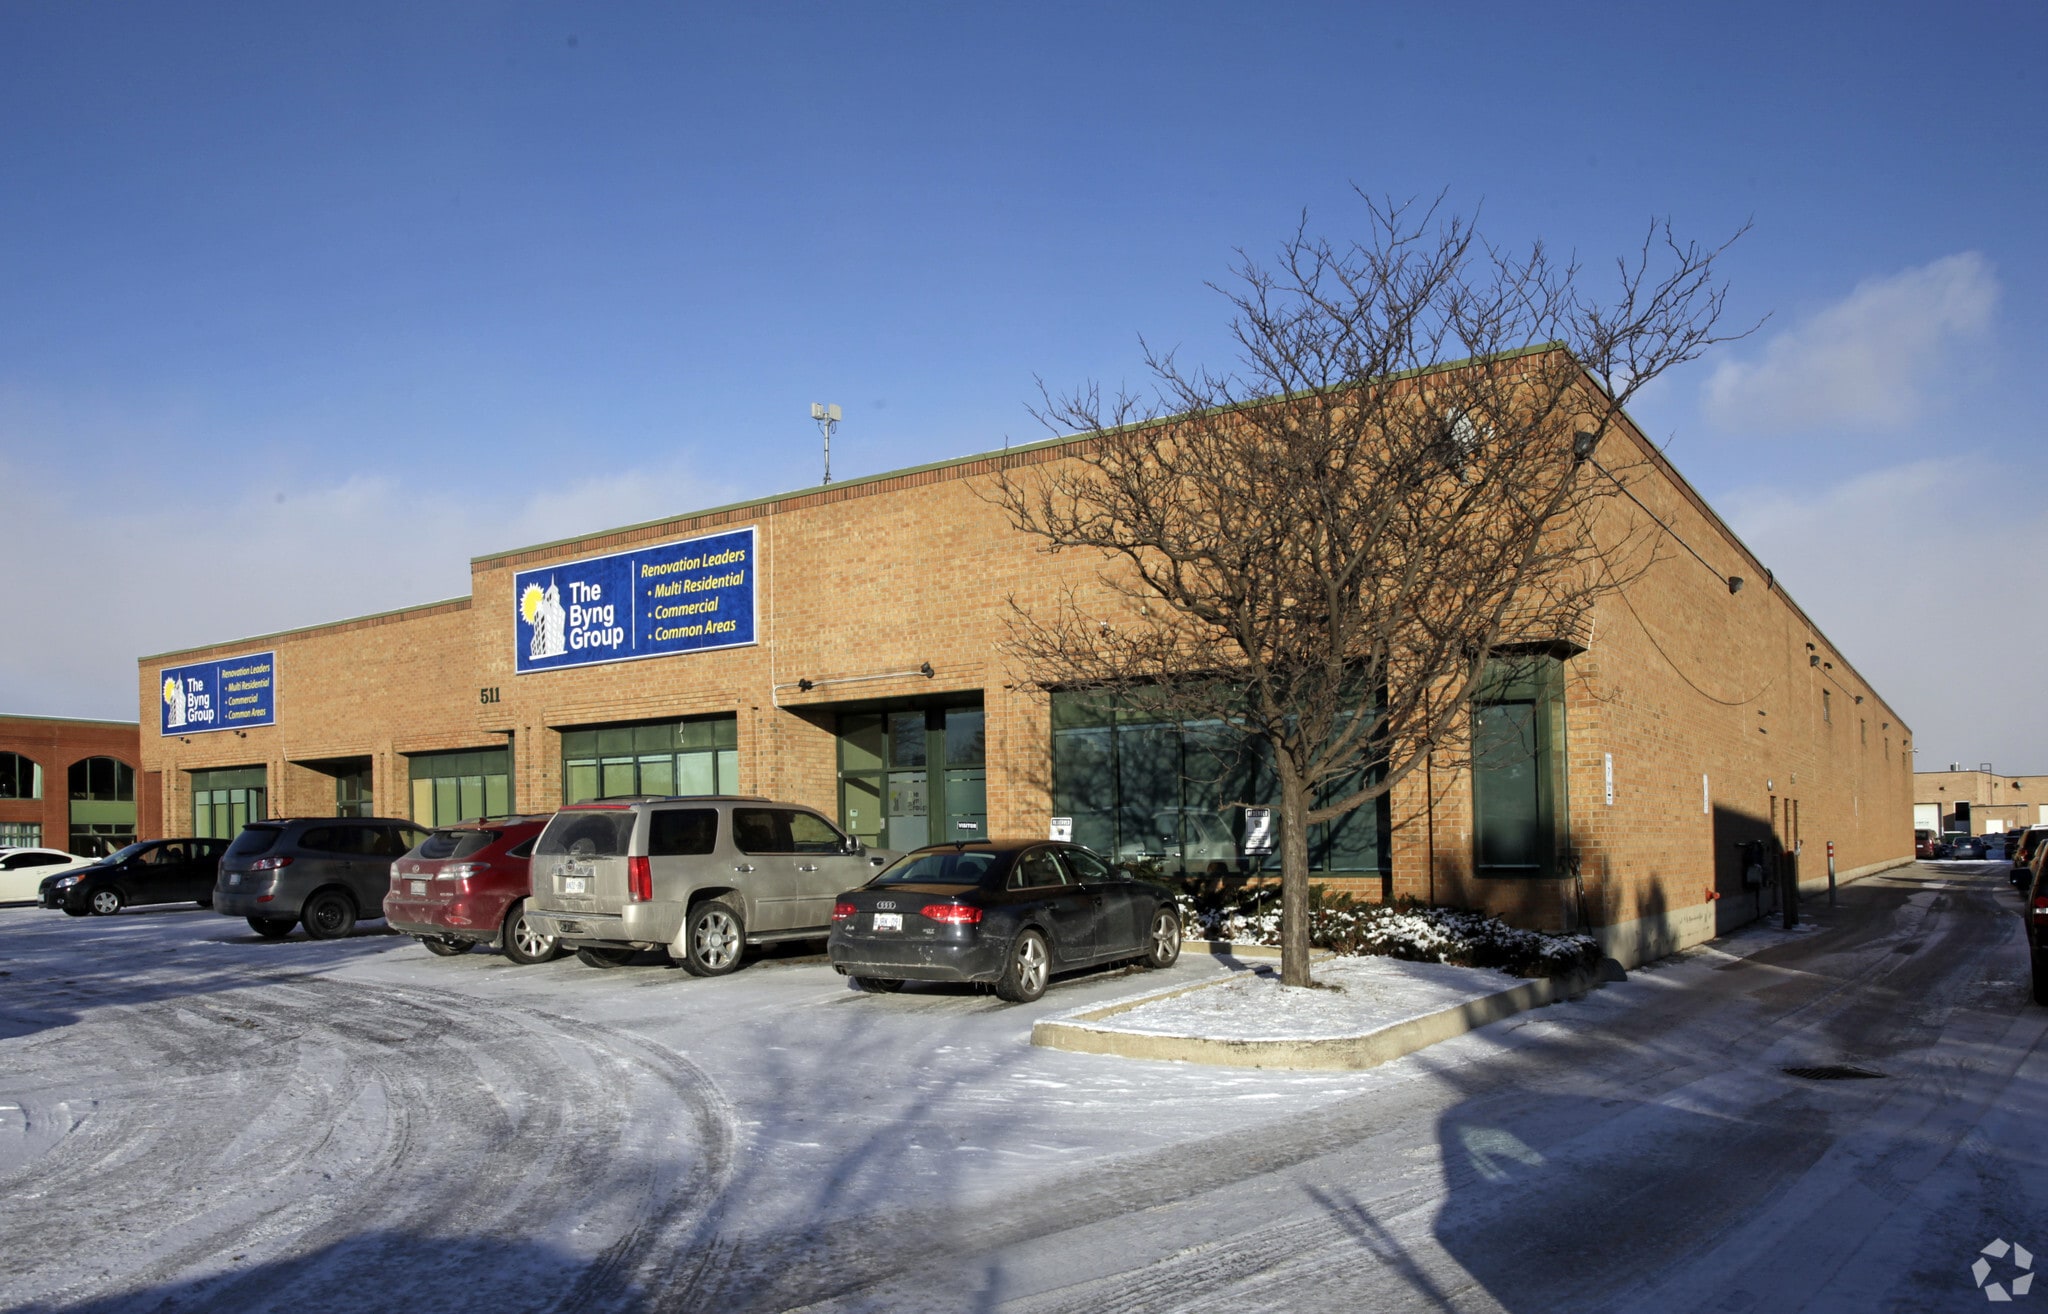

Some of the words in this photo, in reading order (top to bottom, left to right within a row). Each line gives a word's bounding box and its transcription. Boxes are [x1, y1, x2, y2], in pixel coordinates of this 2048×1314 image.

[641, 556, 701, 579] Renovation
[702, 548, 746, 568] Leaders
[569, 581, 602, 604] The
[654, 580, 682, 599] Multi
[683, 569, 745, 594] Residential
[569, 604, 615, 631] Byng
[654, 596, 719, 620] Commercial
[569, 626, 625, 650] Group
[654, 624, 703, 642] Common
[704, 619, 737, 635] Areas
[187, 677, 204, 692] The
[480, 686, 501, 705] 511
[187, 692, 210, 710] Byng
[187, 708, 214, 724] Group
